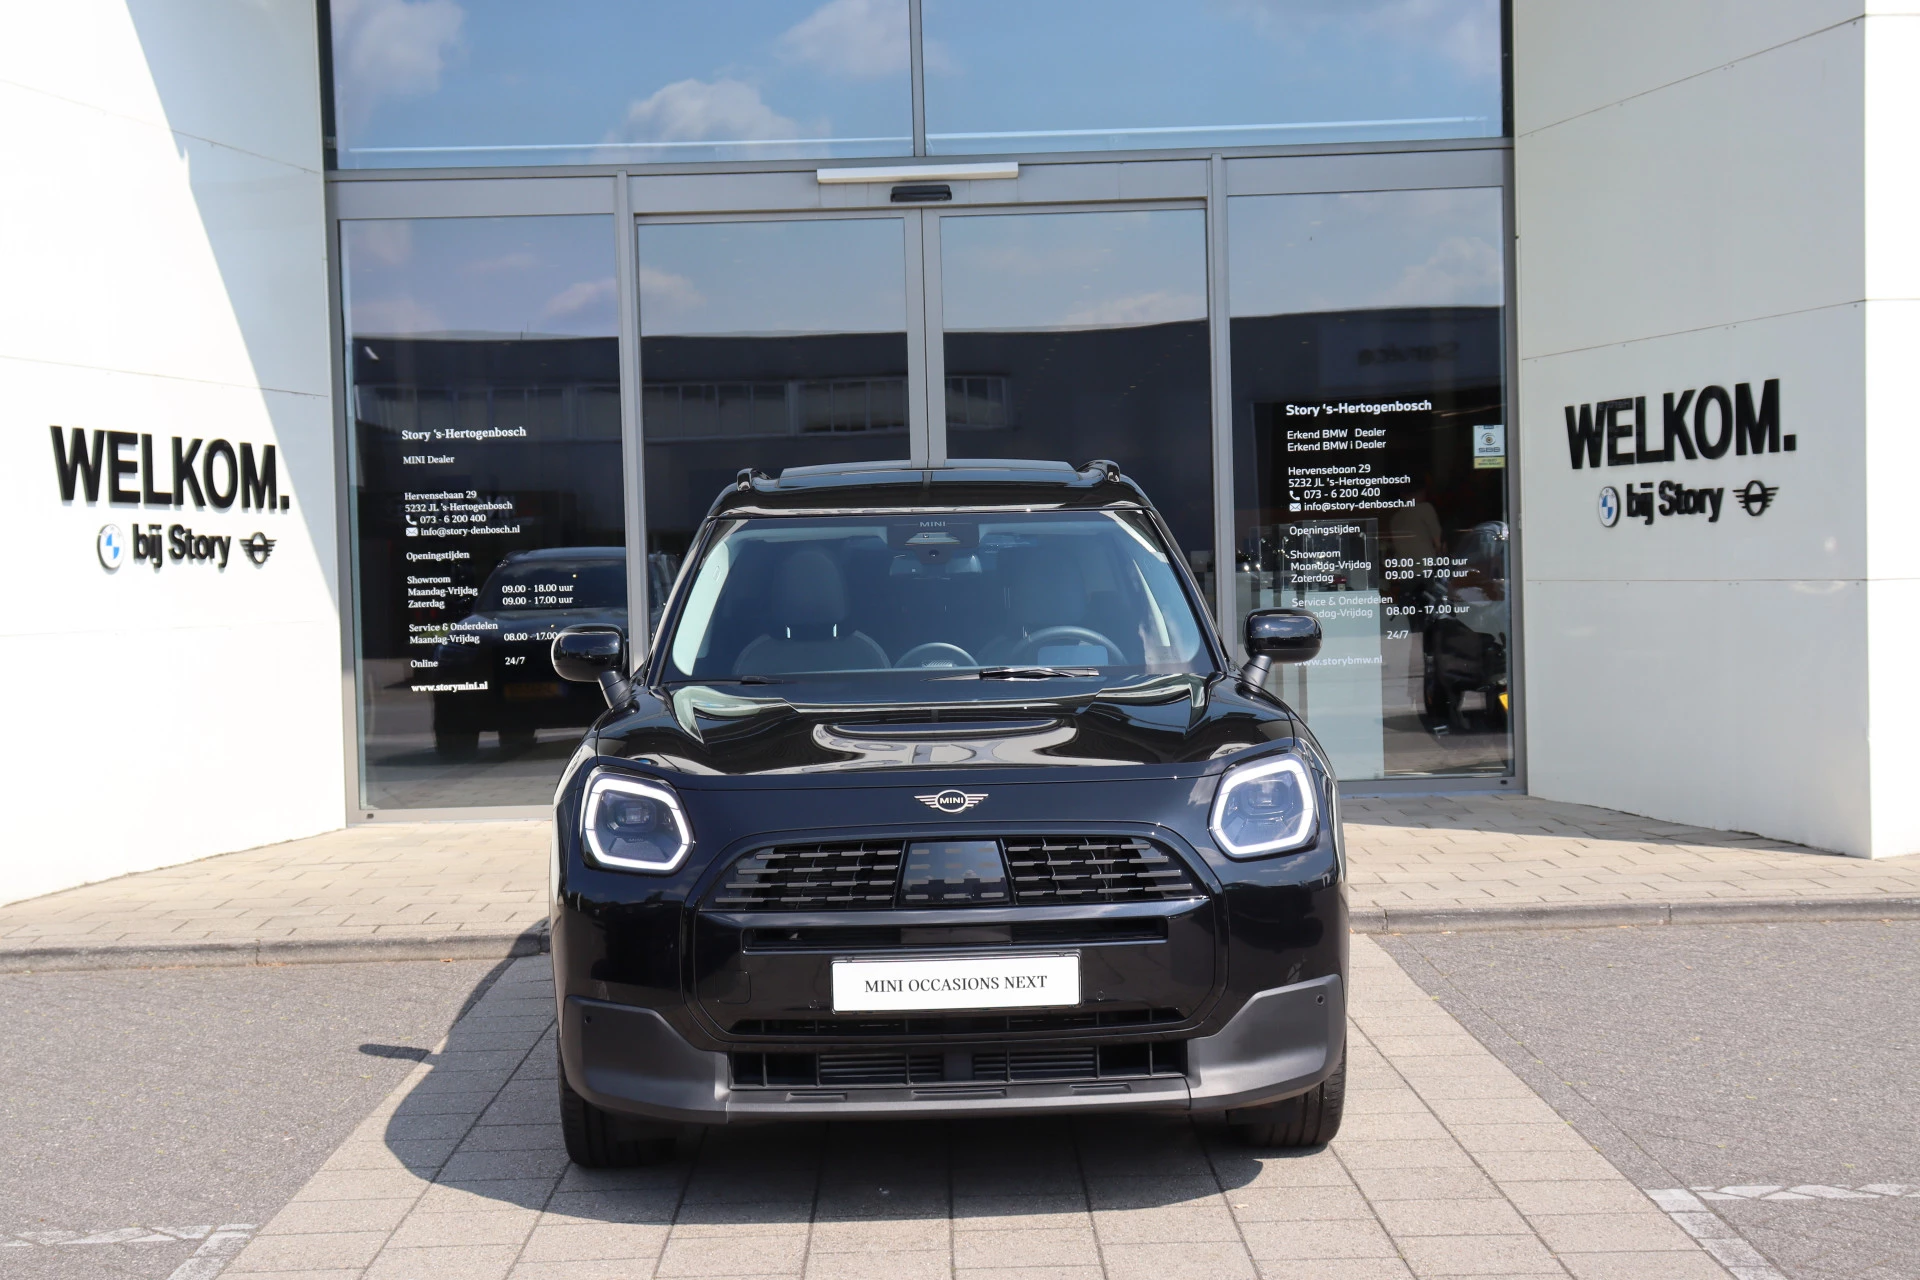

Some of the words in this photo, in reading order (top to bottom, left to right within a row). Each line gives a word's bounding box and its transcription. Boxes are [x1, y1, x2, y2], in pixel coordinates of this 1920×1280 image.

[1286, 404, 1320, 417] Story
[1564, 378, 1797, 470] WELKOM.
[402, 429, 430, 441] Story
[1287, 430, 1320, 440] Erkend
[1322, 429, 1348, 438] BMW
[1355, 428, 1386, 437] Dealer
[1287, 442, 1320, 451] Erkend
[1323, 441, 1348, 450] BMW
[1350, 441, 1353, 449] i
[1355, 440, 1386, 449] Dealer
[403, 456, 425, 464] MINI
[427, 455, 455, 464] Dealer
[50, 425, 290, 510] WELKOM.
[1288, 465, 1356, 476] Hervensebaan
[1358, 464, 1371, 473] 29
[1288, 478, 1312, 487] 5232
[1314, 477, 1325, 487] JL
[404, 491, 464, 501] Hervensebaan
[466, 491, 477, 499] 29
[1304, 489, 1321, 499] 073
[1331, 489, 1337, 498] 6
[1339, 488, 1358, 498] 200
[1361, 488, 1381, 497] 400
[405, 504, 426, 513] 5232
[428, 503, 439, 512] JL
[1304, 499, 1416, 513] info@story-denbosch.nl
[1626, 482, 1654, 525] bij
[1658, 480, 1724, 522] Story
[420, 515, 436, 524] 073
[444, 515, 450, 523] 6
[452, 514, 468, 523] 200
[469, 514, 487, 522] 400
[420, 525, 520, 538] info@story-denbosch.nl
[1289, 525, 1360, 537] Openingstijden
[133, 523, 162, 569] bij
[168, 524, 231, 569] Story
[406, 551, 470, 562] Openingstijden
[1290, 550, 1341, 559] Showroom
[1291, 561, 1372, 572] Maandag-Vrijdag
[1385, 558, 1414, 568] 09.00
[1422, 557, 1450, 567] 18.00
[1452, 558, 1468, 566] uur
[407, 576, 451, 585] Showroom
[1291, 574, 1334, 584] Zaterdag
[1385, 570, 1414, 580] 09.00
[1453, 570, 1469, 578] uur
[408, 587, 478, 597] Maandag-Vrijdag
[502, 585, 526, 594] 09.00
[533, 584, 557, 593] 18.00
[559, 584, 574, 593] uur
[408, 600, 445, 610] Zaterdag
[502, 597, 527, 606] 09.00
[534, 596, 557, 605] 17.00
[559, 596, 574, 605] uur
[1292, 597, 1327, 607] Service
[1329, 597, 1336, 606] &
[1338, 596, 1393, 606] Onderdelen
[1313, 608, 1373, 619] ndag-Vrijdag
[1386, 606, 1416, 616] 08.00
[1454, 606, 1470, 614] uur
[409, 624, 439, 633] Service
[442, 623, 448, 631] &
[450, 622, 498, 631] Onderdelen
[410, 635, 480, 645] Maandag-Vrijdag
[504, 632, 528, 642] 08.00
[1386, 630, 1409, 640] 24/7
[410, 659, 438, 669] Online
[505, 656, 525, 666] 24/7
[411, 682, 488, 693] www.storymini.nl
[864, 979, 904, 993] MINI
[908, 976, 1000, 992] OCCASIONS
[1004, 975, 1048, 990] NEXT
